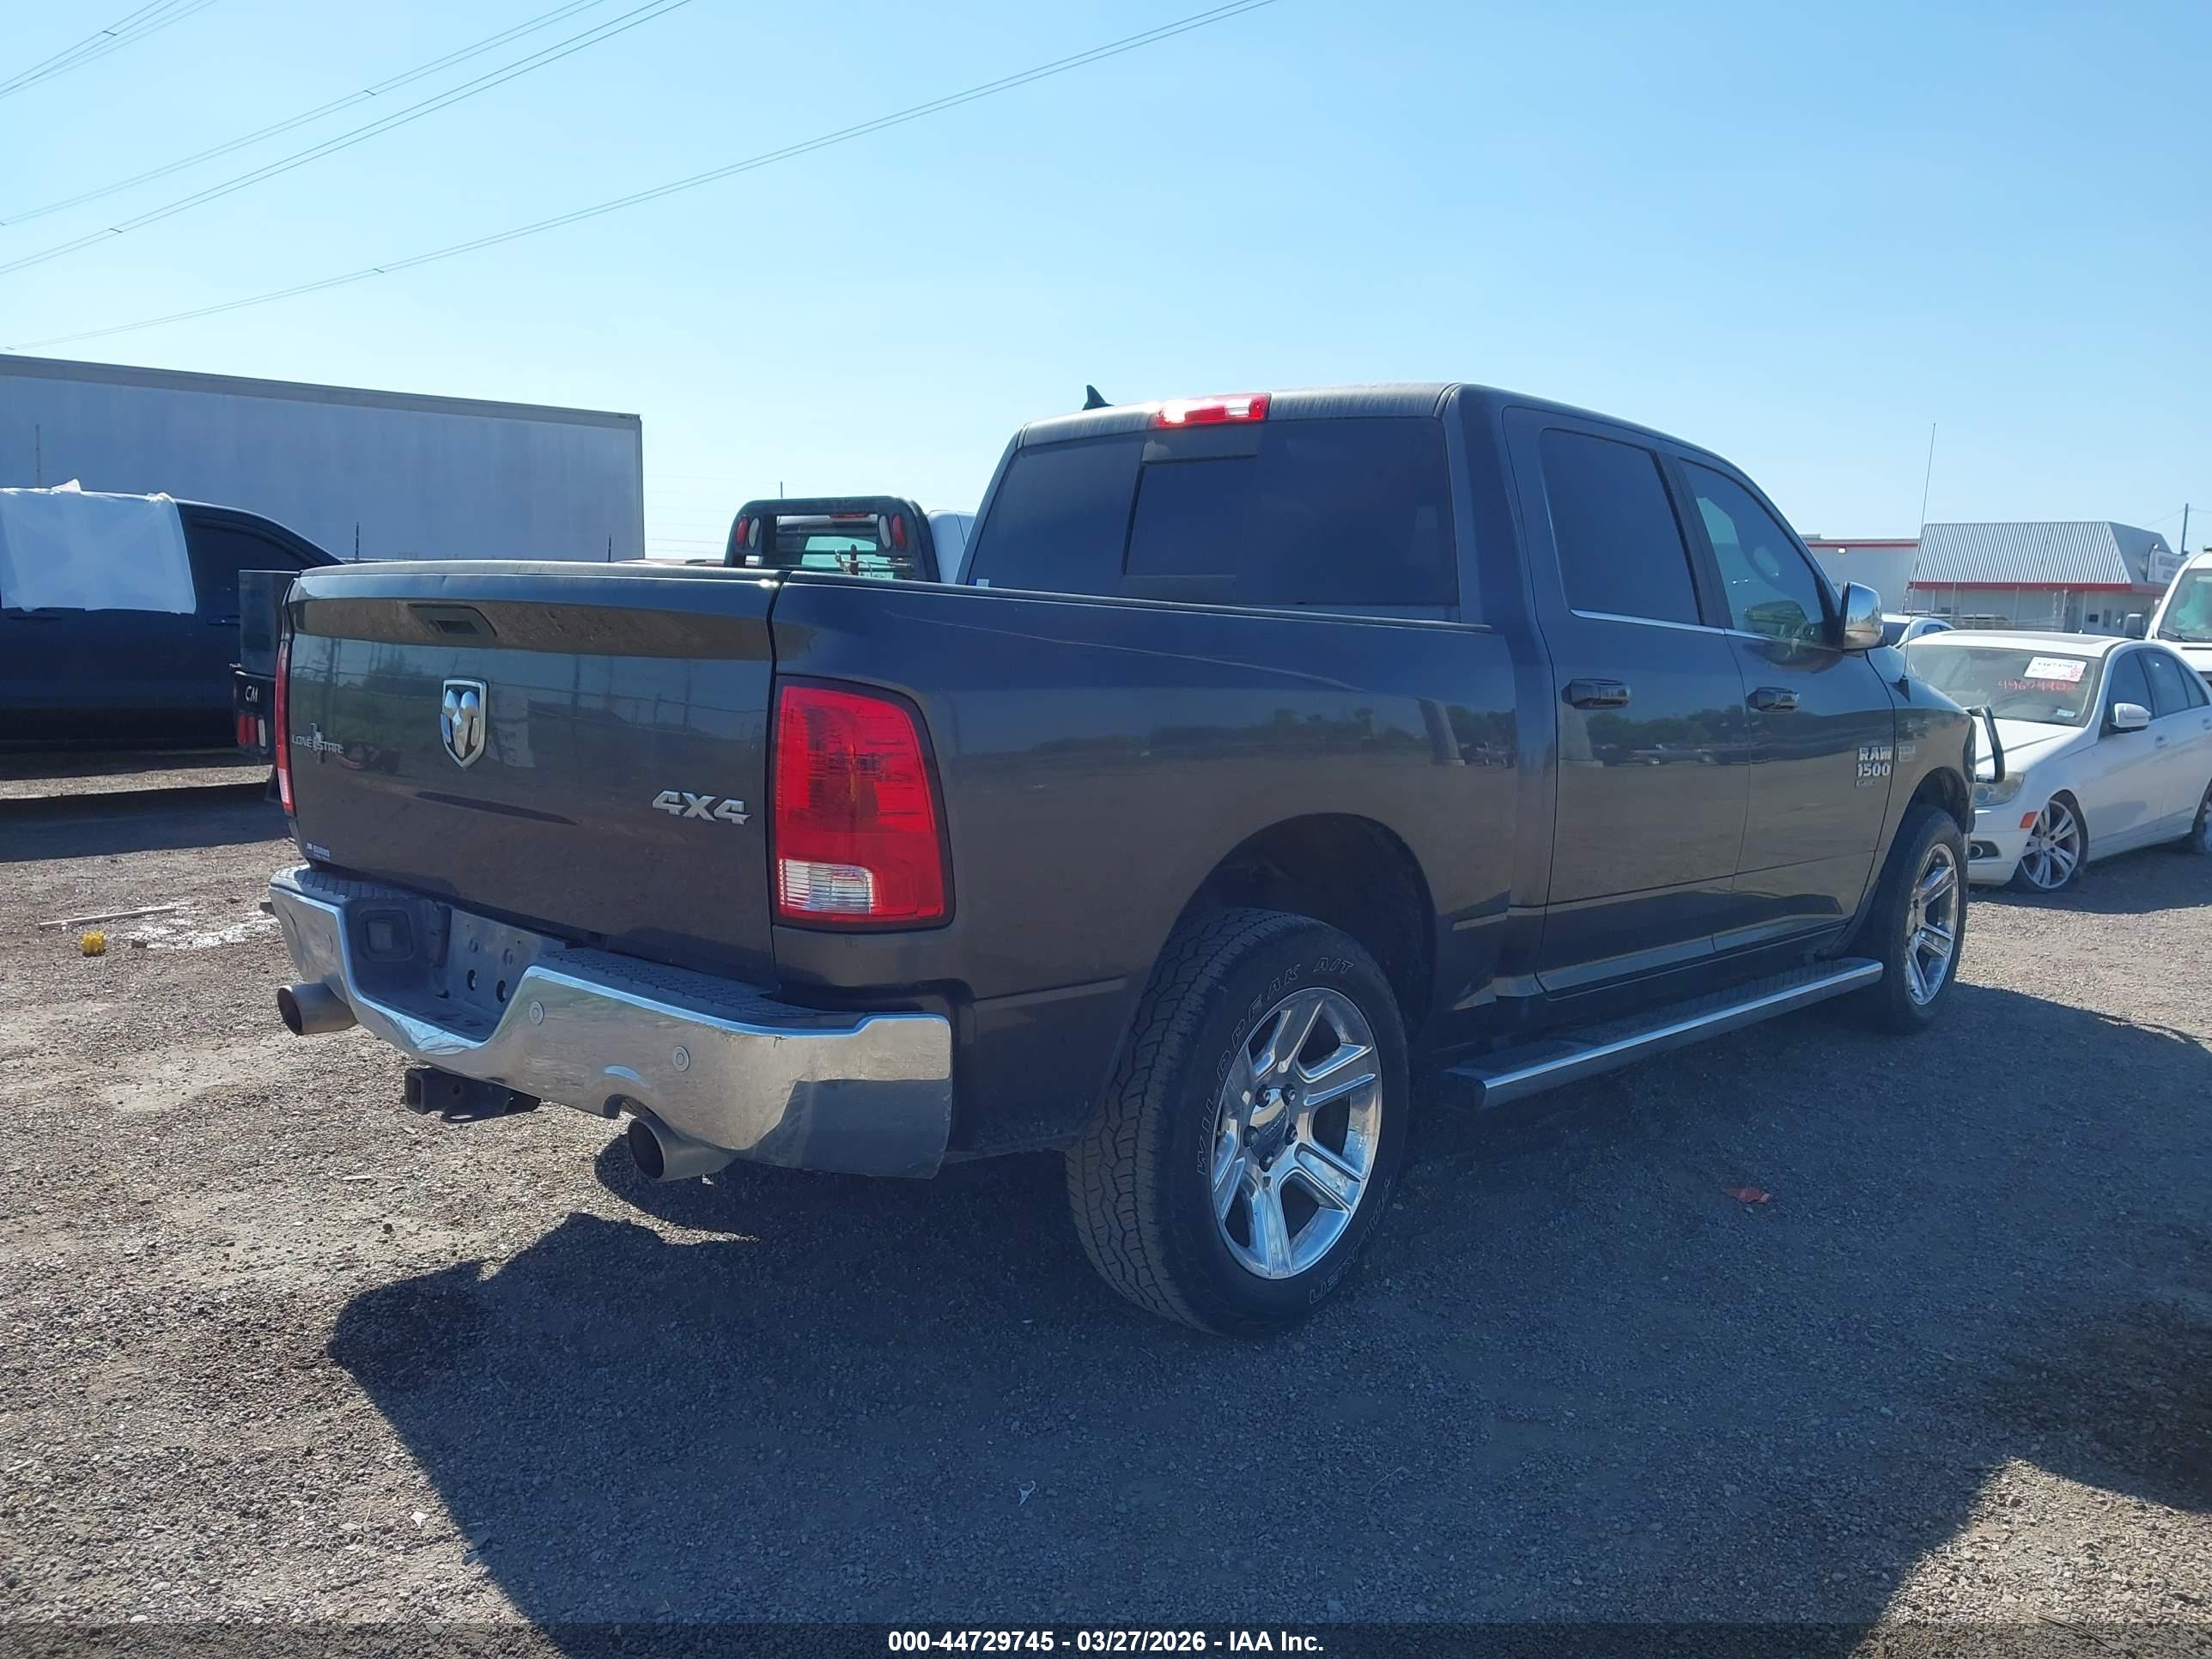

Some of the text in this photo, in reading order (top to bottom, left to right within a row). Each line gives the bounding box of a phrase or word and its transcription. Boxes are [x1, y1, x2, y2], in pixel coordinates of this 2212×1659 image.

[246, 685, 258, 702] CM
[292, 734, 343, 754] LONE STAR
[1858, 746, 1892, 761] RAM
[1857, 762, 1891, 777] 1500
[653, 790, 752, 824] 4X4
[1312, 957, 1354, 974] A/T
